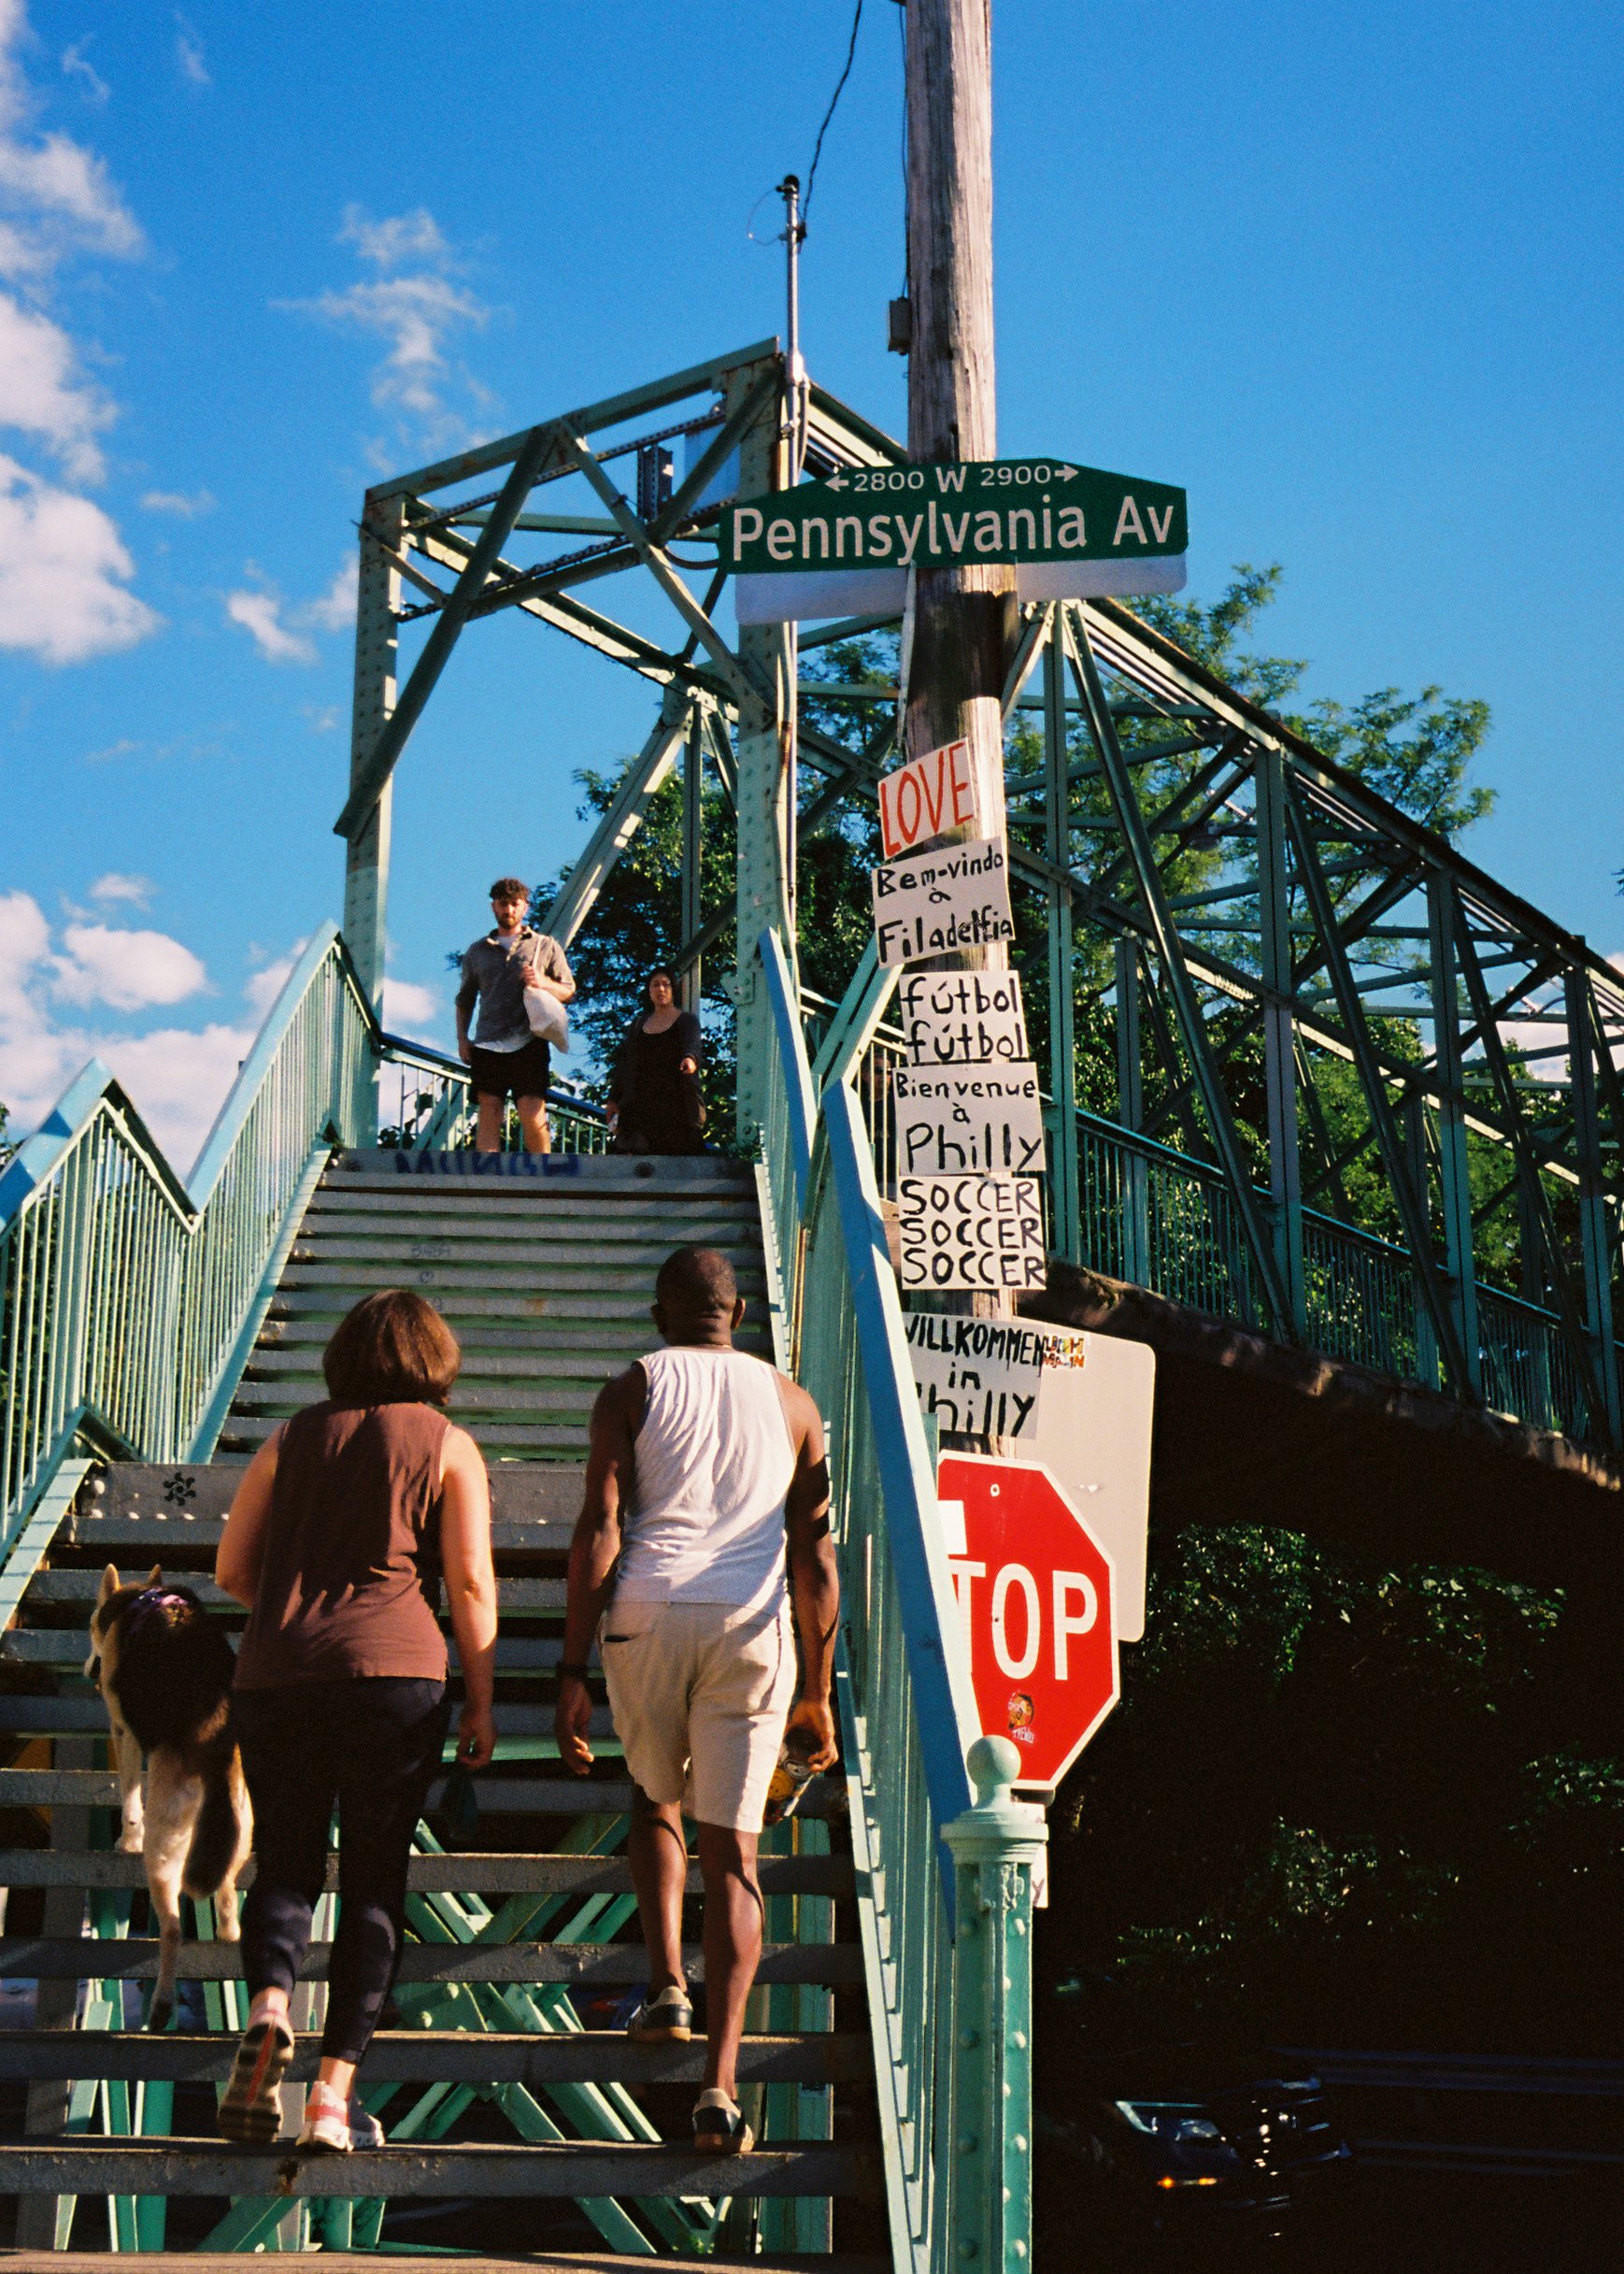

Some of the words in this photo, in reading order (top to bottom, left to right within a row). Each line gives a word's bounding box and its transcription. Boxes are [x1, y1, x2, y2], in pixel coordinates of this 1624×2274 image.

[853, 470, 925, 493] 2800
[934, 465, 968, 493] W
[980, 465, 1052, 487] 2900
[733, 493, 1088, 566] Pennsylvania
[1112, 494, 1174, 547] Av
[879, 741, 975, 857] LOVE
[876, 844, 1004, 898] Bem-vindo
[878, 905, 1015, 964] Filadelfia
[900, 976, 1019, 1018] fútbol
[904, 1019, 1024, 1064] fútbol
[895, 1072, 1036, 1099] Bienvenue
[952, 1101, 971, 1123] à
[905, 1122, 1042, 1173] Philly
[900, 1178, 1041, 1216] SOCCER
[899, 1217, 1044, 1249] SOCCER
[901, 1247, 1047, 1288] SOCCER
[948, 1361, 981, 1391] in
[915, 1381, 1035, 1437] hilly
[948, 1558, 1099, 1680] TOP
